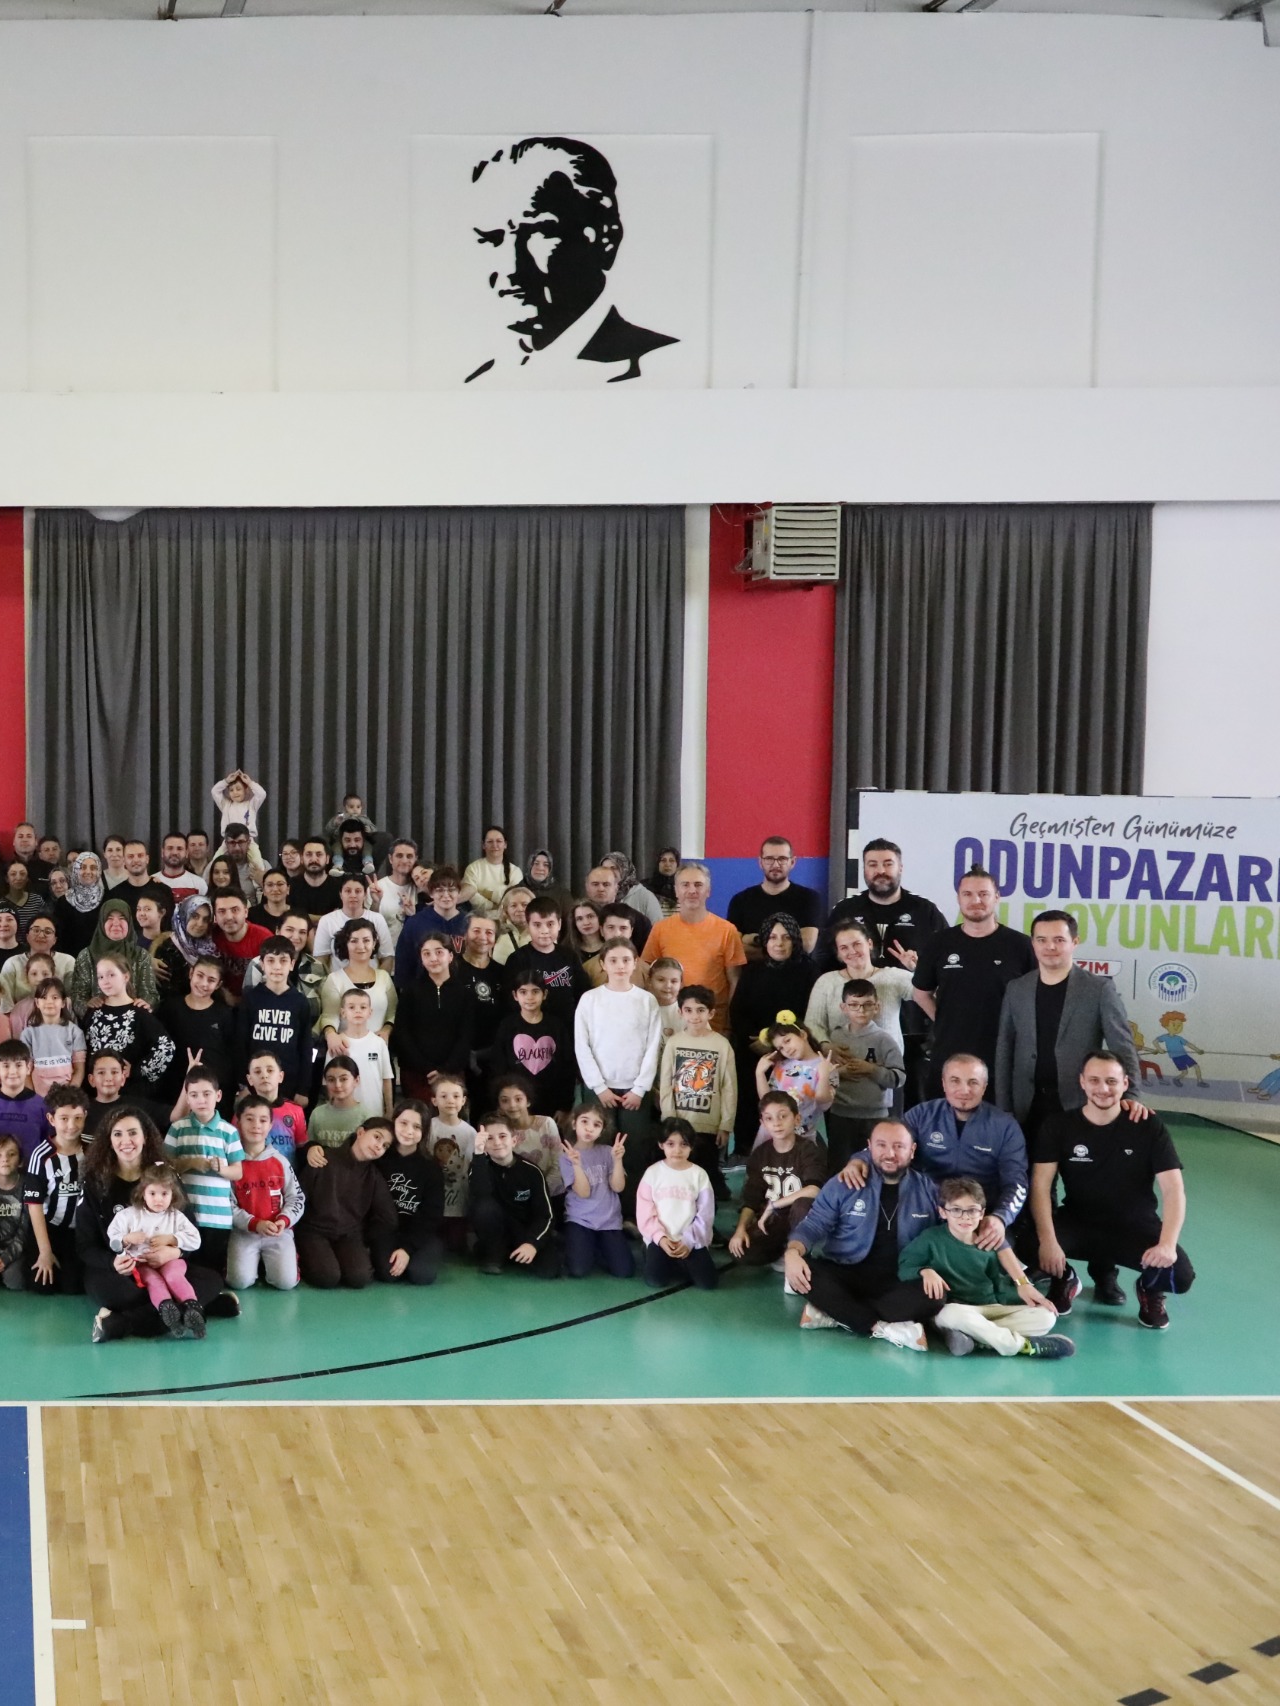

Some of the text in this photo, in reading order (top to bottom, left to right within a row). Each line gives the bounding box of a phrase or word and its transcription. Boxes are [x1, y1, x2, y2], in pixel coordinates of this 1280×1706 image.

[1009, 812, 1238, 843] Geçmişten Günümüze
[1063, 902, 1280, 961] OYUNLAR
[258, 1008, 292, 1026] NEVER
[252, 1023, 295, 1044] GIVE UP
[864, 1047, 878, 1064] A
[675, 1093, 711, 1110] WILD
